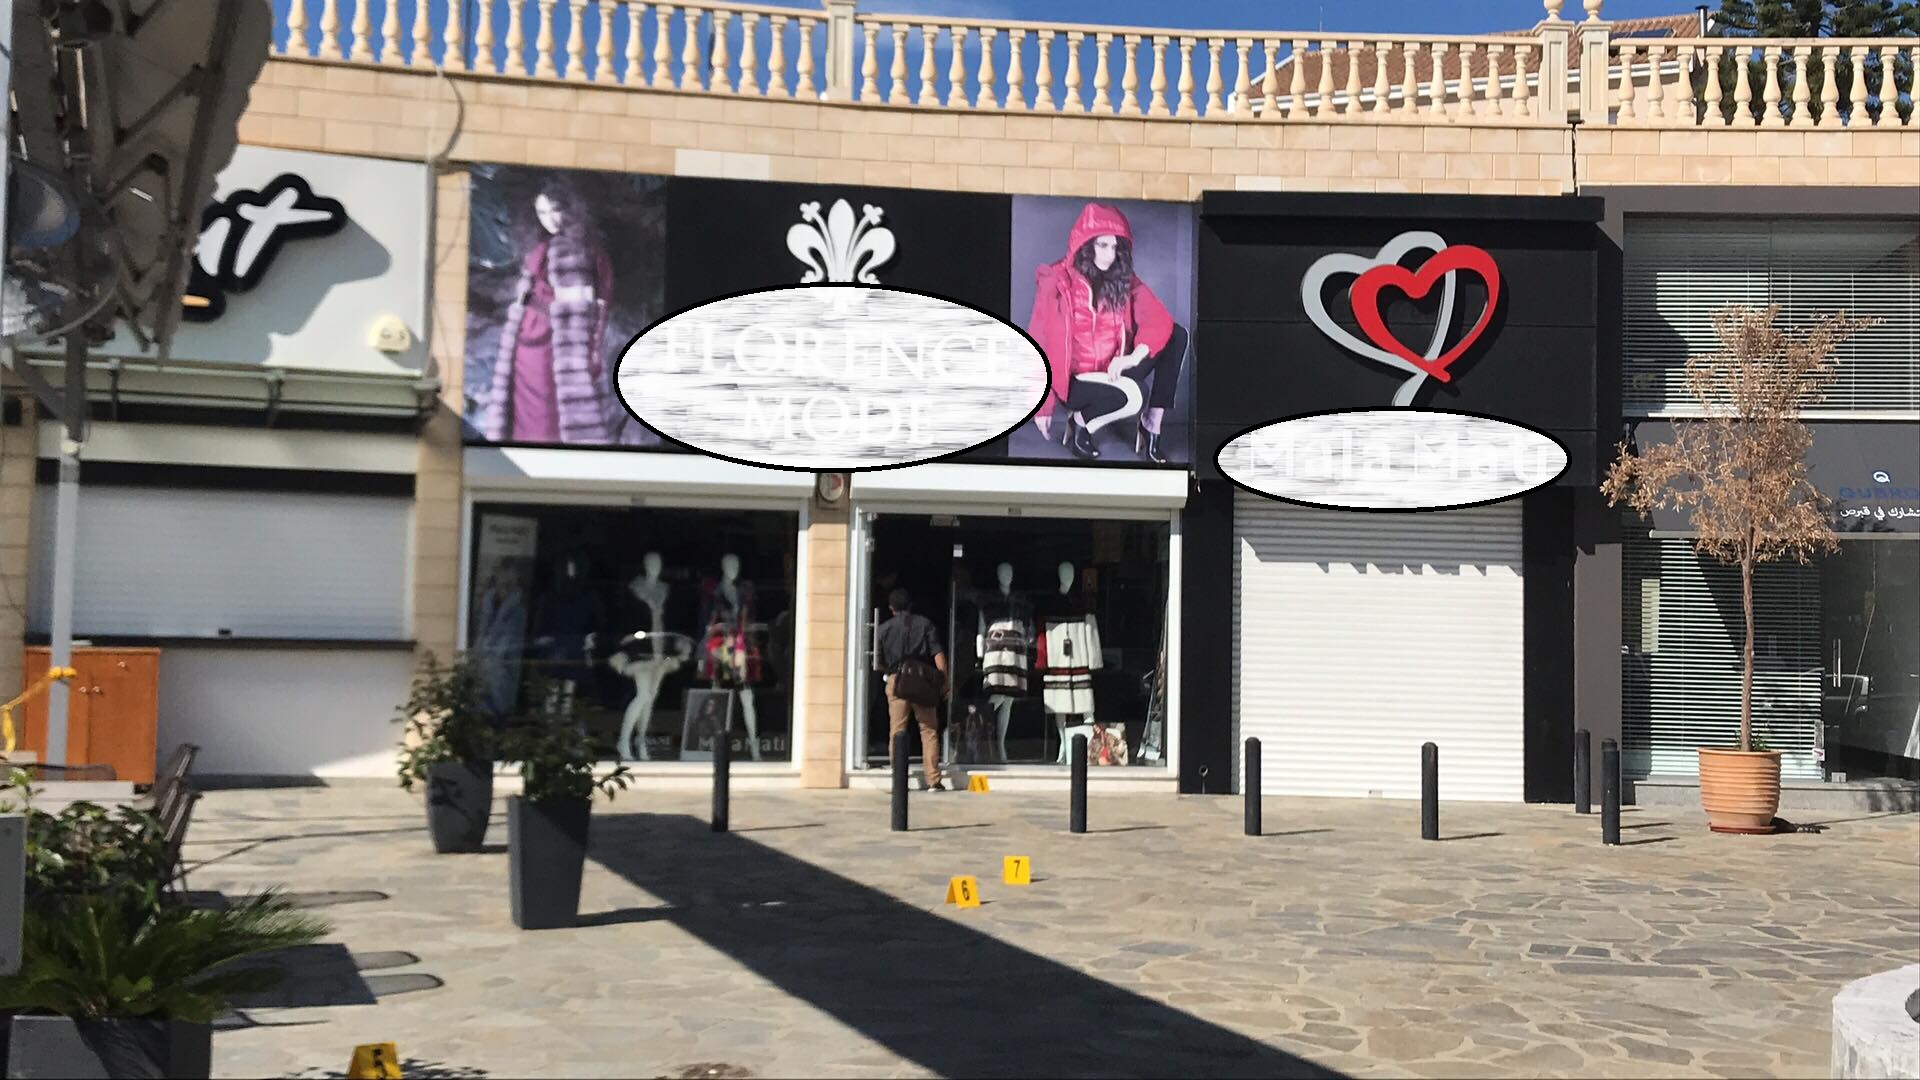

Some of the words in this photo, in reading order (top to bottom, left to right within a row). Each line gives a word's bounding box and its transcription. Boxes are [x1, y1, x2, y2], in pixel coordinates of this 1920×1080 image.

[739, 392, 934, 445] MODE
[1013, 859, 1021, 879] 7
[961, 879, 970, 901] 6
